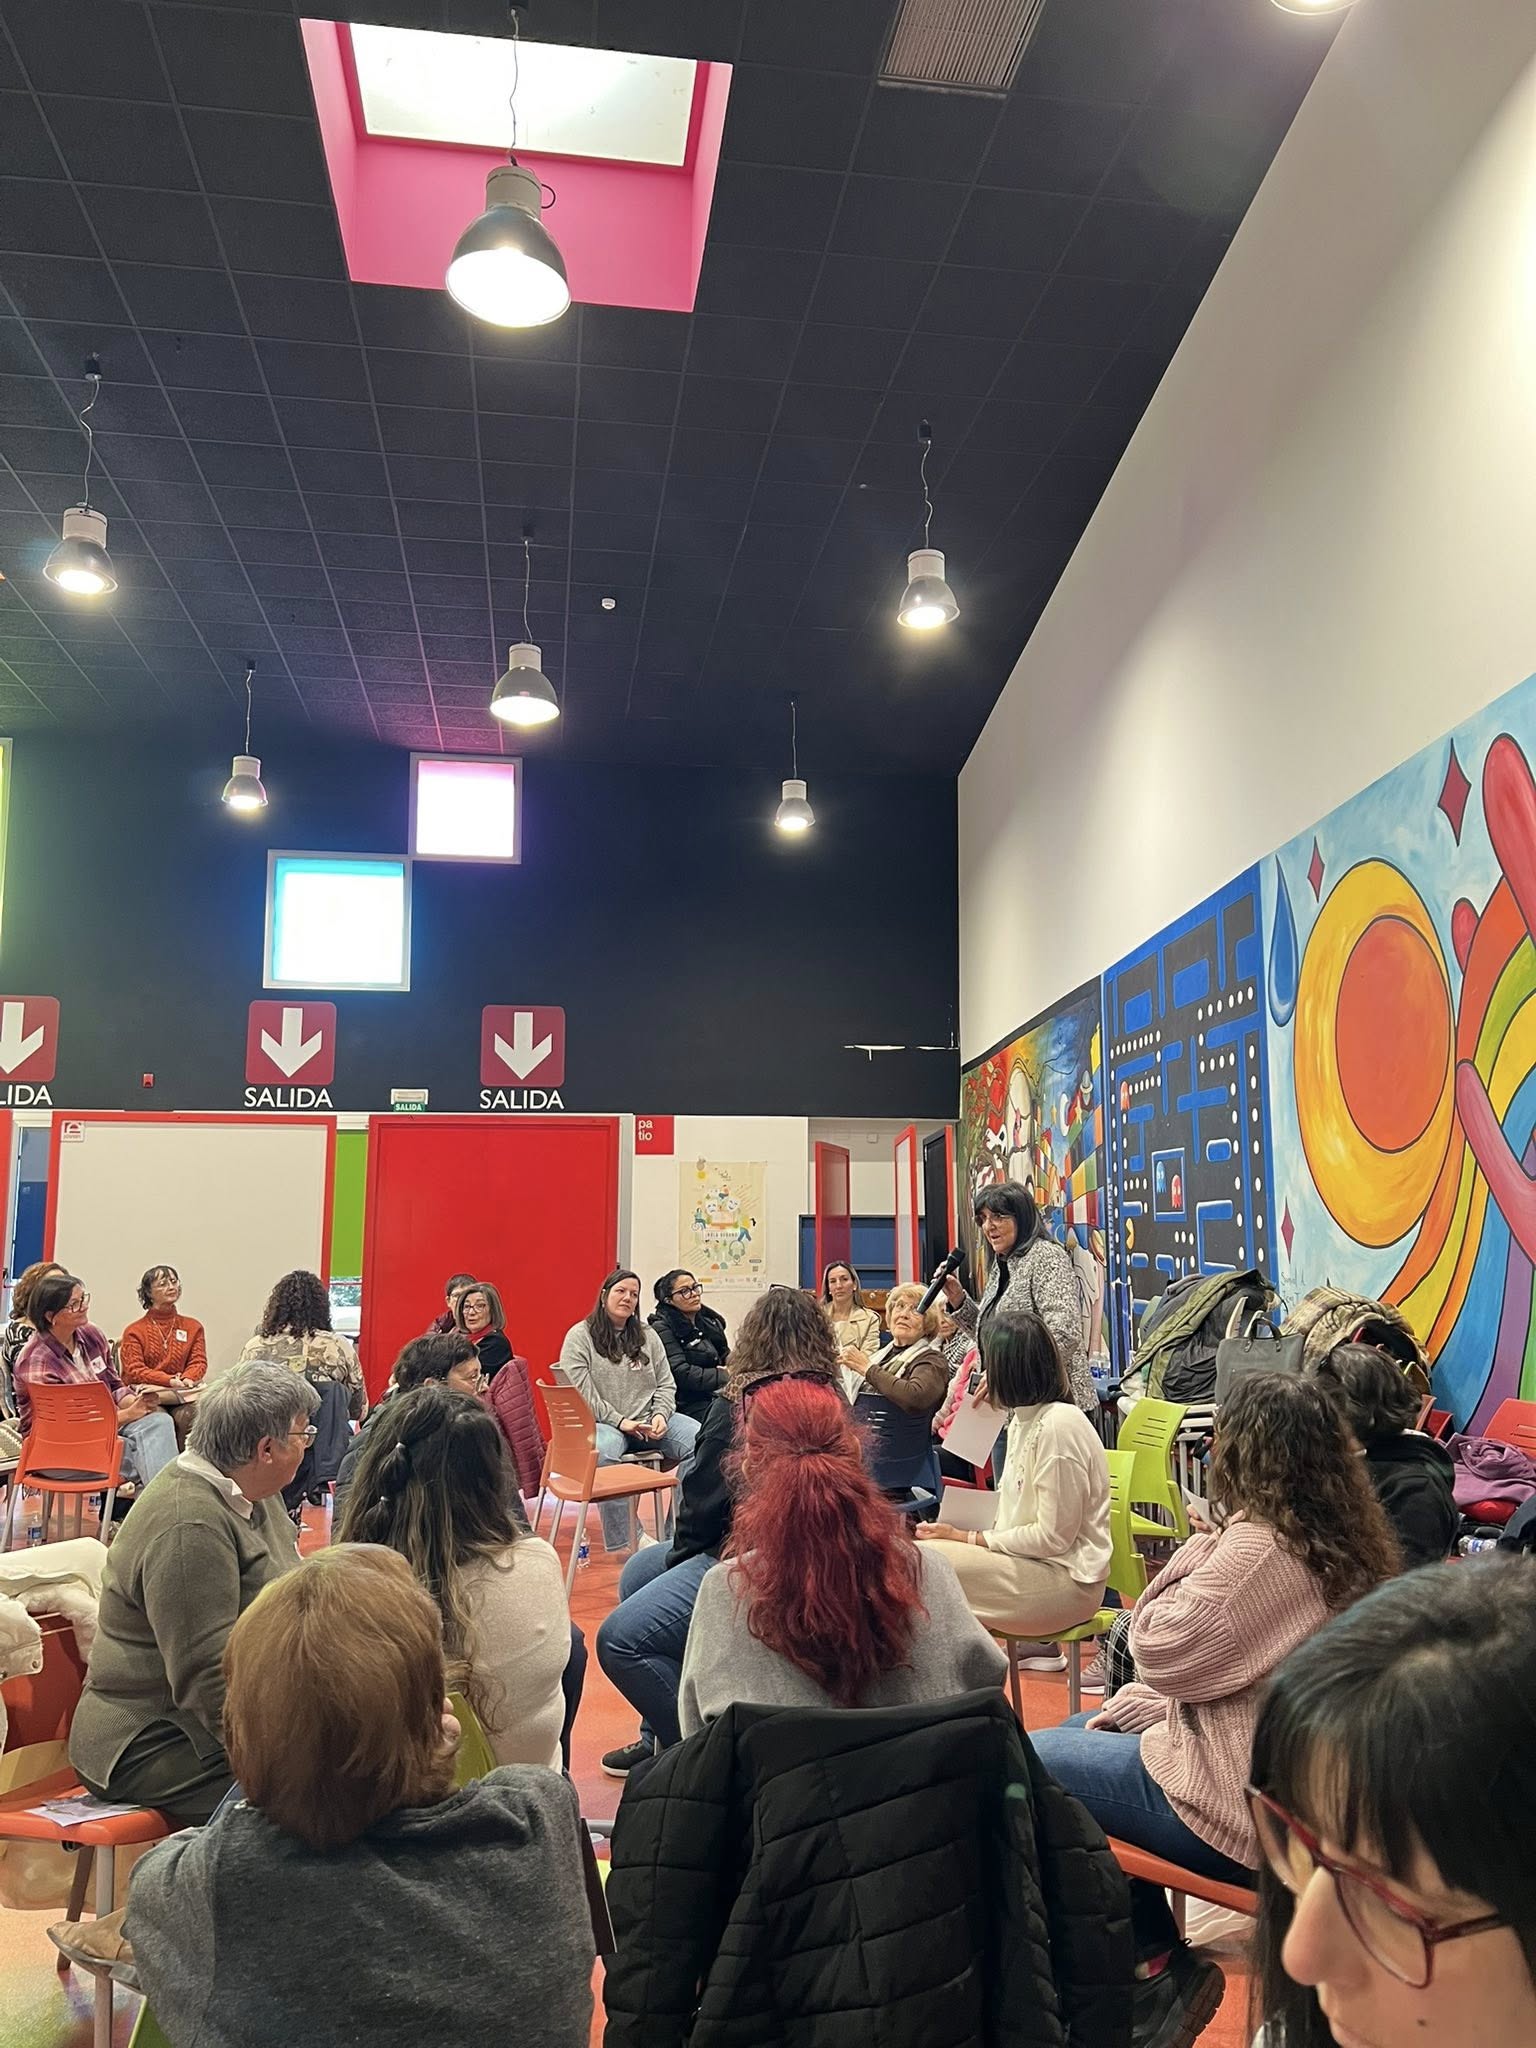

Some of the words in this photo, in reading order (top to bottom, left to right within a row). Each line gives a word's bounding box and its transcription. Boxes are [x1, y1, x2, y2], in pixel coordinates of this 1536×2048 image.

[244, 1087, 334, 1108] SALIDA
[479, 1089, 565, 1110] SALIDA
[395, 1103, 422, 1111] SALIDA
[638, 1119, 653, 1131] pa
[638, 1130, 653, 1141] tio
